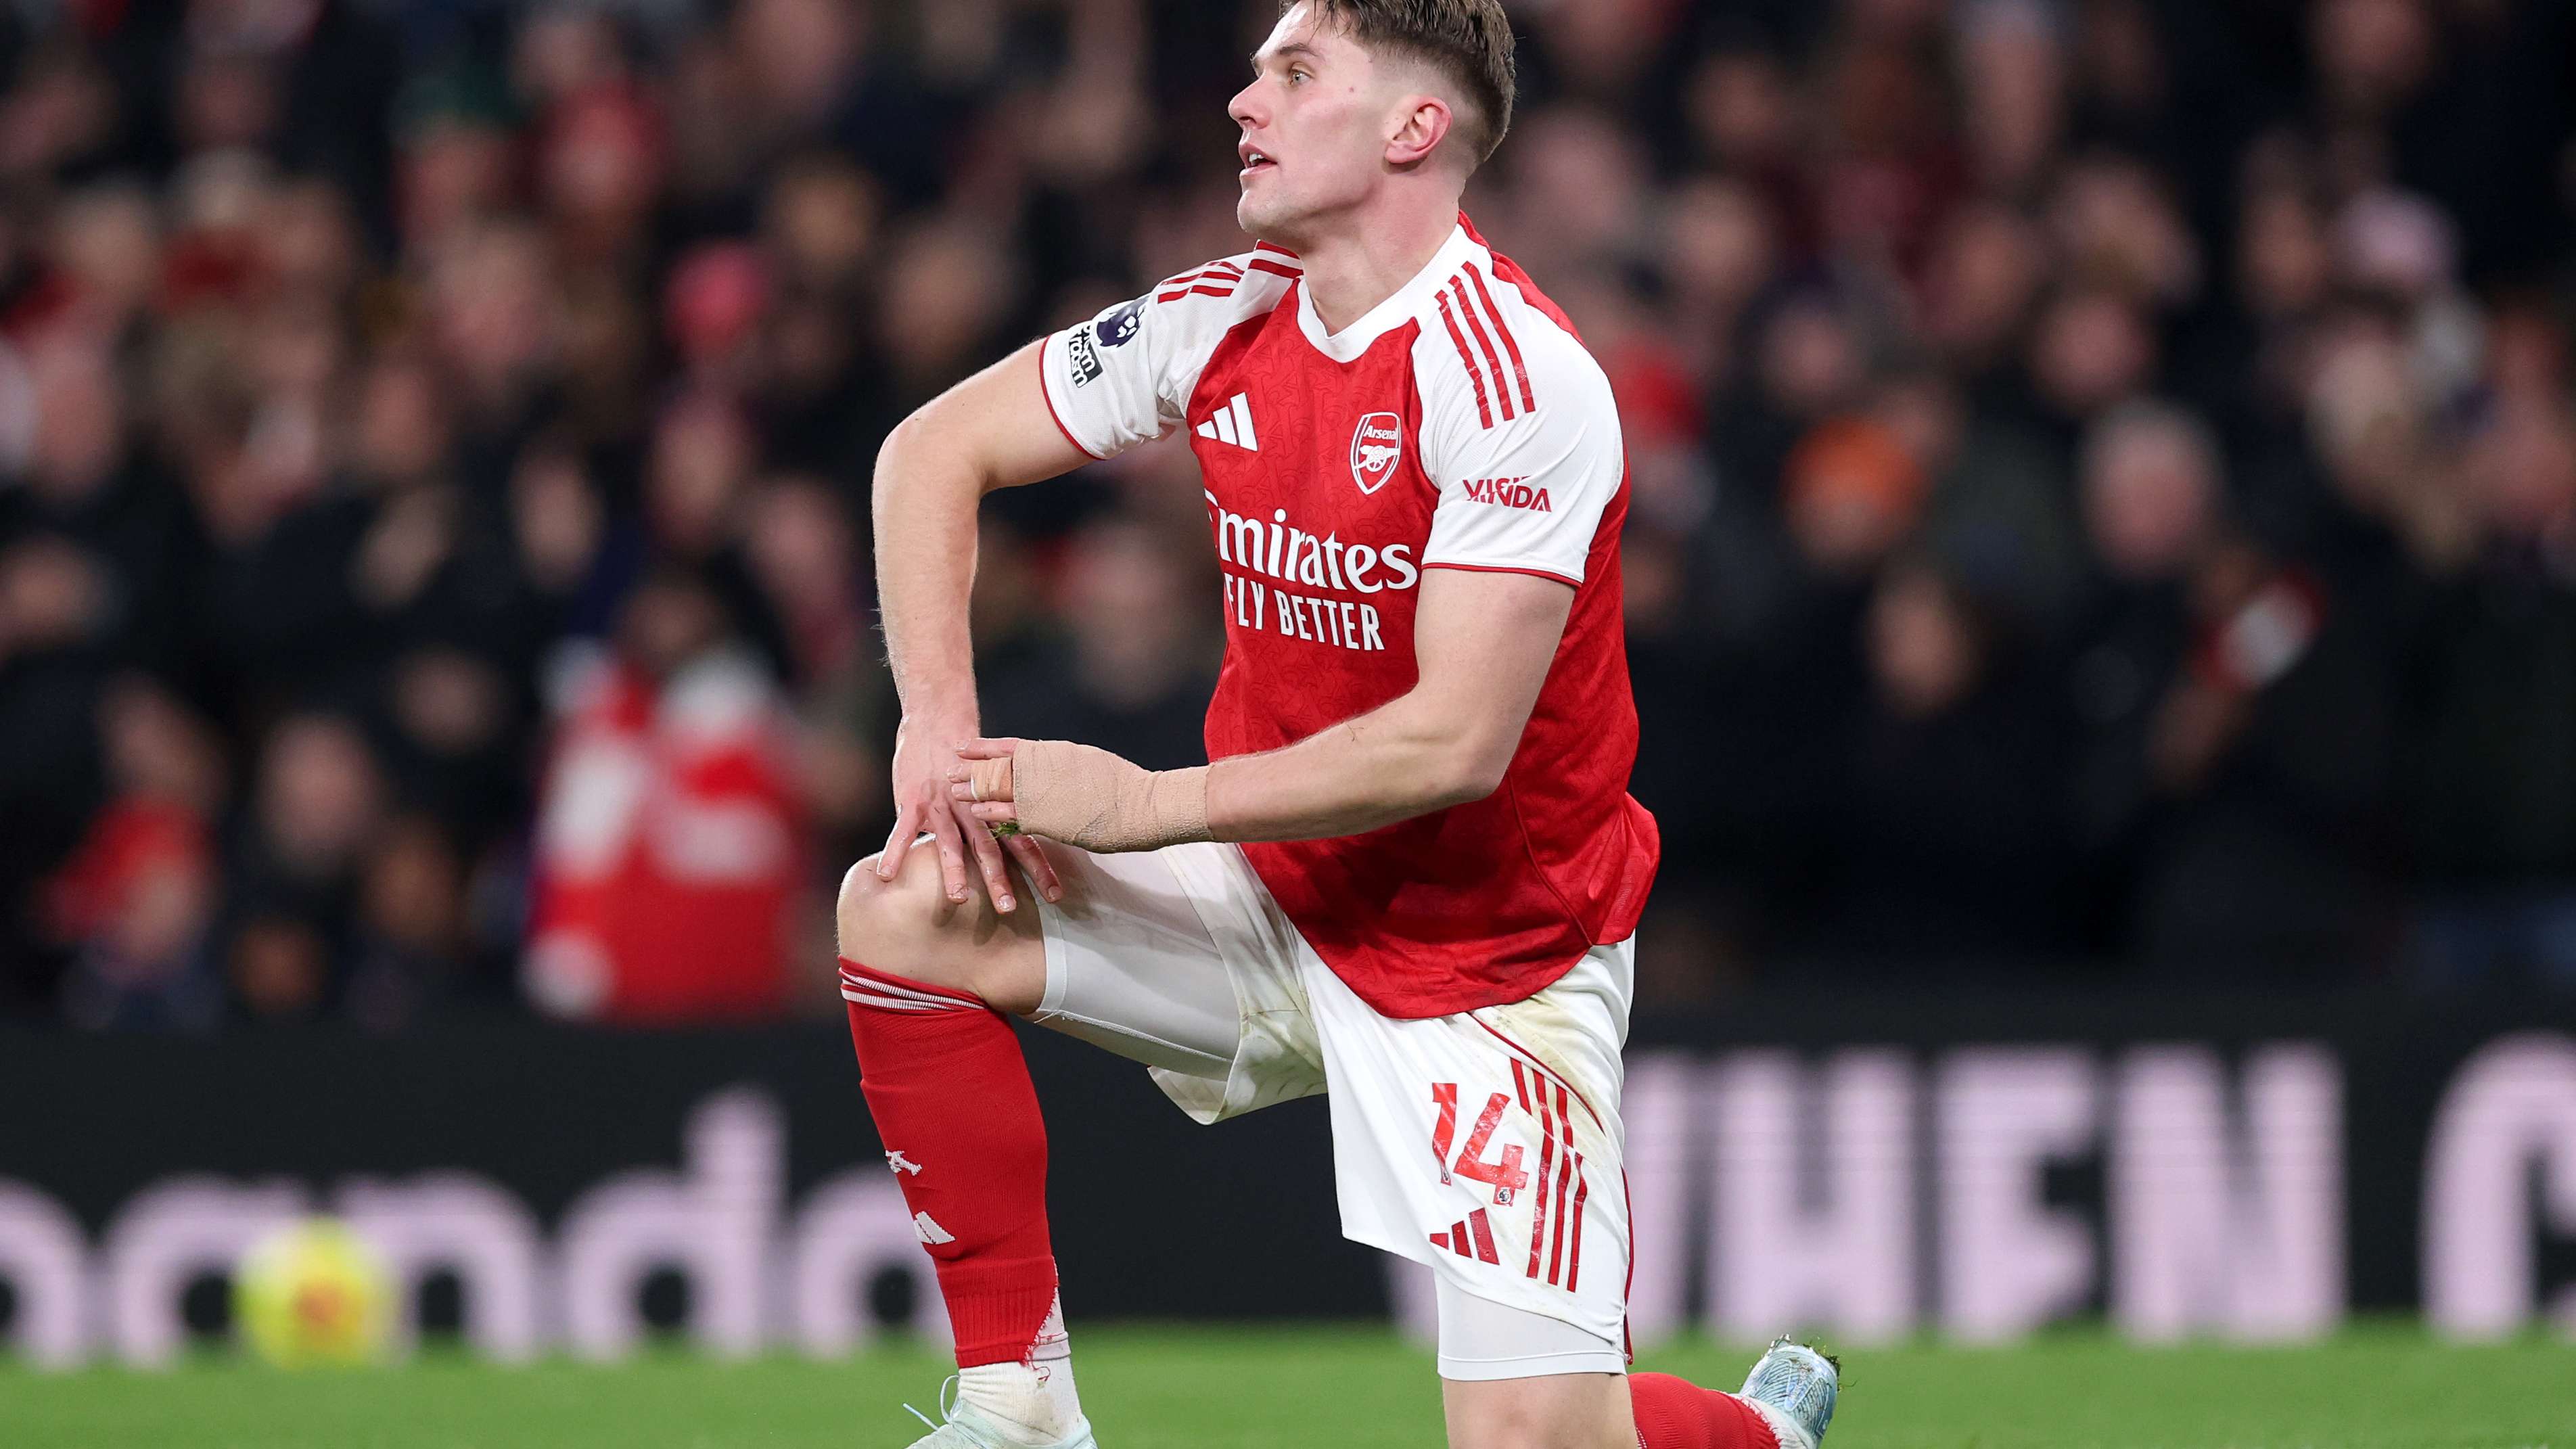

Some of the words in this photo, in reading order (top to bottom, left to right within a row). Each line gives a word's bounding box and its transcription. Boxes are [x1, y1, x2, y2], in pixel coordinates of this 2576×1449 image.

[1363, 425, 1398, 440] Arsenal
[1204, 488, 1418, 594] mirates
[1274, 589, 1385, 651] BETTER
[1432, 1082, 1529, 1206] 14
